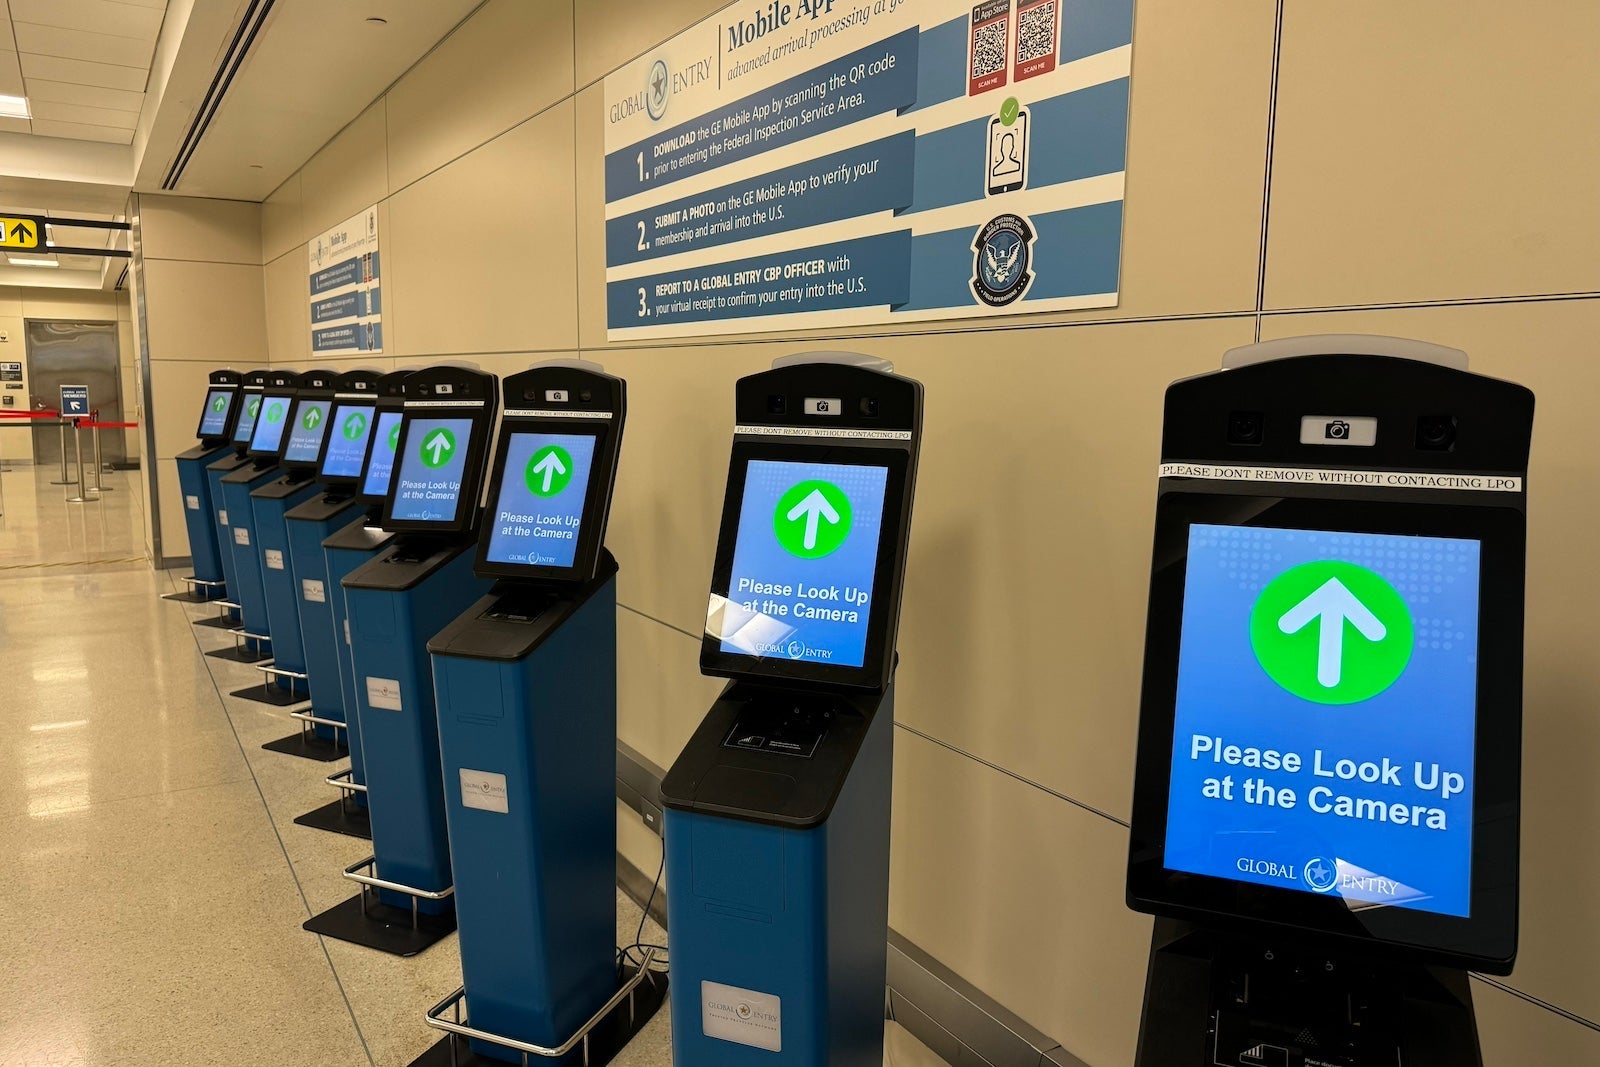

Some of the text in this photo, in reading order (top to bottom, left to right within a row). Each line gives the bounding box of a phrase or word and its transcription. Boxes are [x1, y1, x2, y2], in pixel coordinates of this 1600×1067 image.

[728, 1, 791, 52] Mobile
[981, 9, 993, 20] App
[993, 4, 1008, 15] Store
[728, 47, 770, 81] advanced
[772, 29, 808, 61] arrival
[809, 4, 871, 49] processing
[978, 77, 998, 89] SCAN ME
[1023, 62, 1046, 74] SCAN ME
[610, 56, 713, 124] GLOBAL ENTRY
[654, 52, 896, 158] DOWNLOAD the GE Mobile App by scanning the QR code
[654, 93, 866, 179] prior to entering the Federal Inspection Service Area.
[637, 151, 650, 182] 1.
[655, 159, 879, 229] SUBMIT A PHOTO on the GE Mobile App to verify your
[637, 221, 650, 252] 2.
[655, 205, 785, 247] membership and arrival into the U.S.
[655, 255, 850, 297] REPORT TO A GLOBAL ENTRY CBP OFFICER with
[638, 287, 651, 318] 3.
[655, 277, 867, 317] your virtual receipt to confirm your entry into the U.S.
[737, 426, 762, 434] PLEASE
[848, 431, 893, 439] CONTACTING
[401, 480, 460, 491] Please Look Up
[1162, 465, 1515, 490] PLEASE DONT REMOVE WITHOUT CONTACTING LPO
[402, 491, 455, 500] at the Camera
[500, 512, 580, 528] Please Look Up
[501, 526, 573, 539] at the Camera
[738, 577, 869, 607] Please Look Up
[742, 600, 858, 623] at the Camera
[755, 641, 833, 659] GLOBAL ENTRY
[1190, 733, 1465, 799] Please Look Up
[1202, 775, 1447, 830] at the Camera
[1236, 857, 1400, 896] GLOBAL ENTRY
[708, 1001, 778, 1022] GLOBAL ENTRY
[1304, 1057, 1320, 1066] Place
